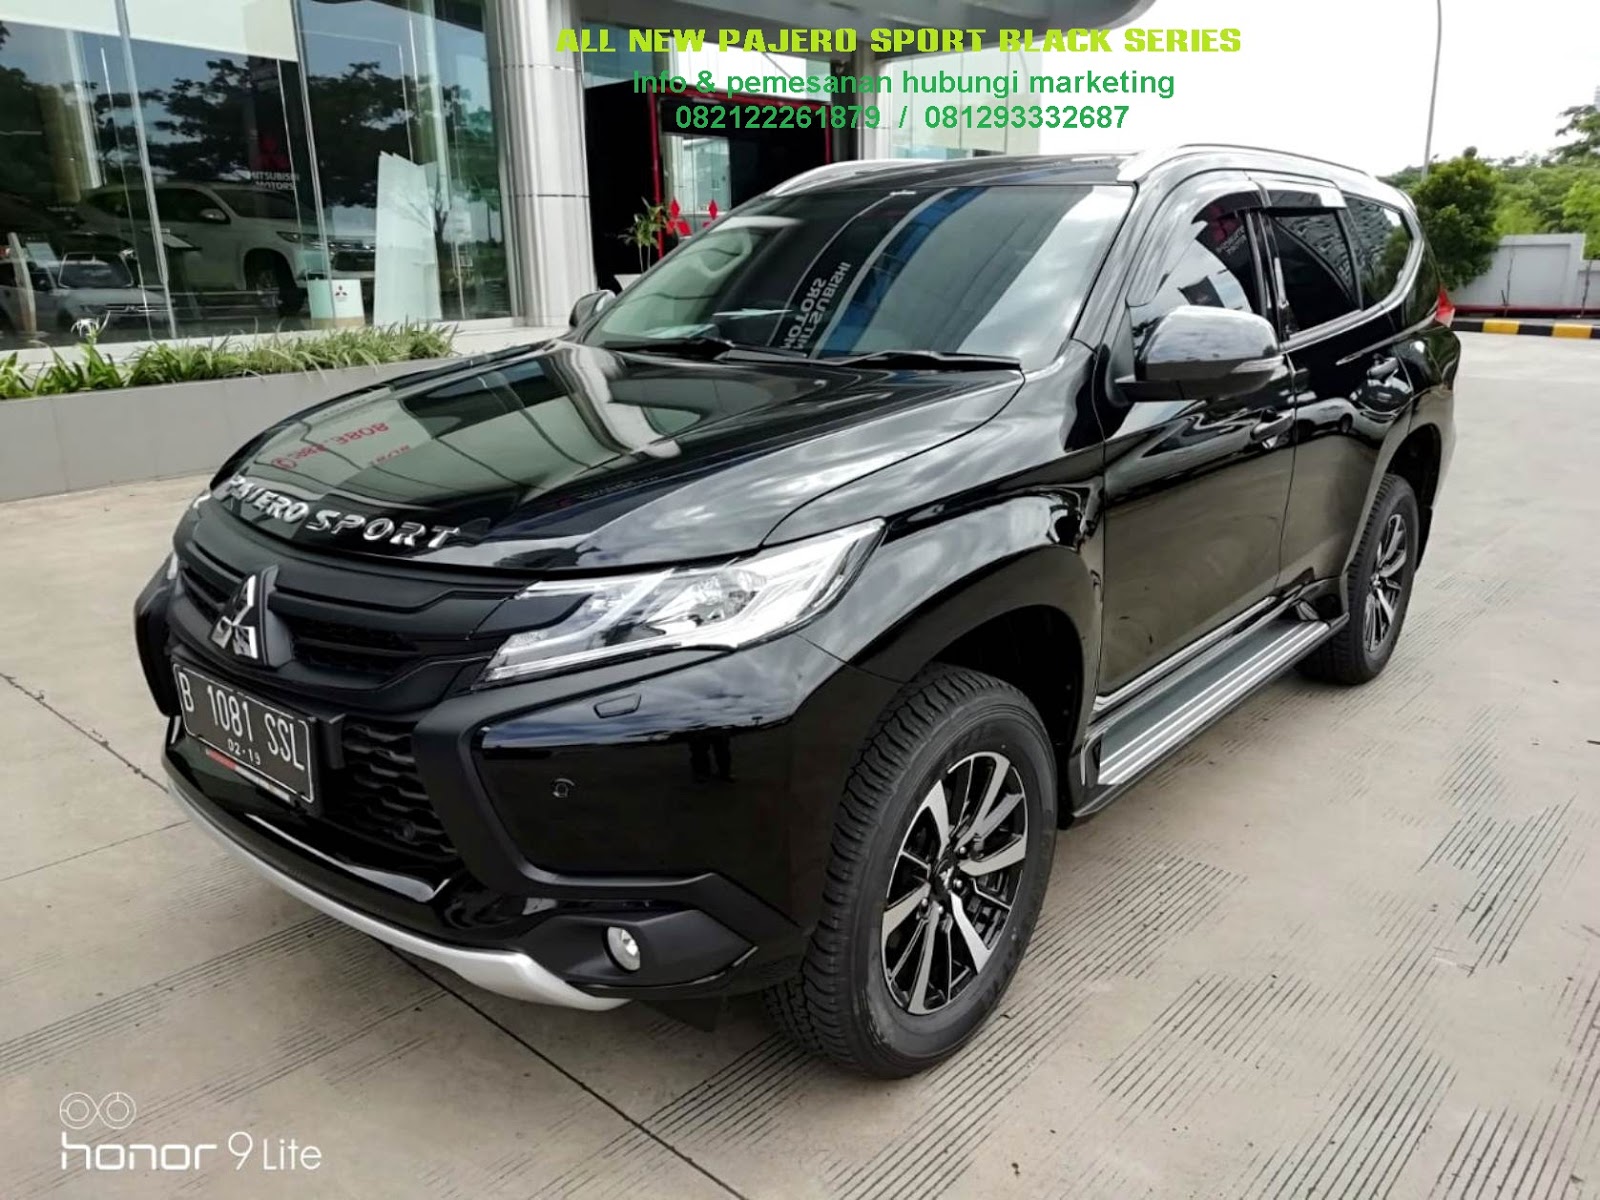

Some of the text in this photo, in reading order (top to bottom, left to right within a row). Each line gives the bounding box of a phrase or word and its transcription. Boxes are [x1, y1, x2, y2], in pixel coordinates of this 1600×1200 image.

[225, 473, 462, 549] PAJERO SPORT
[178, 671, 306, 771] B 1081 SSL
